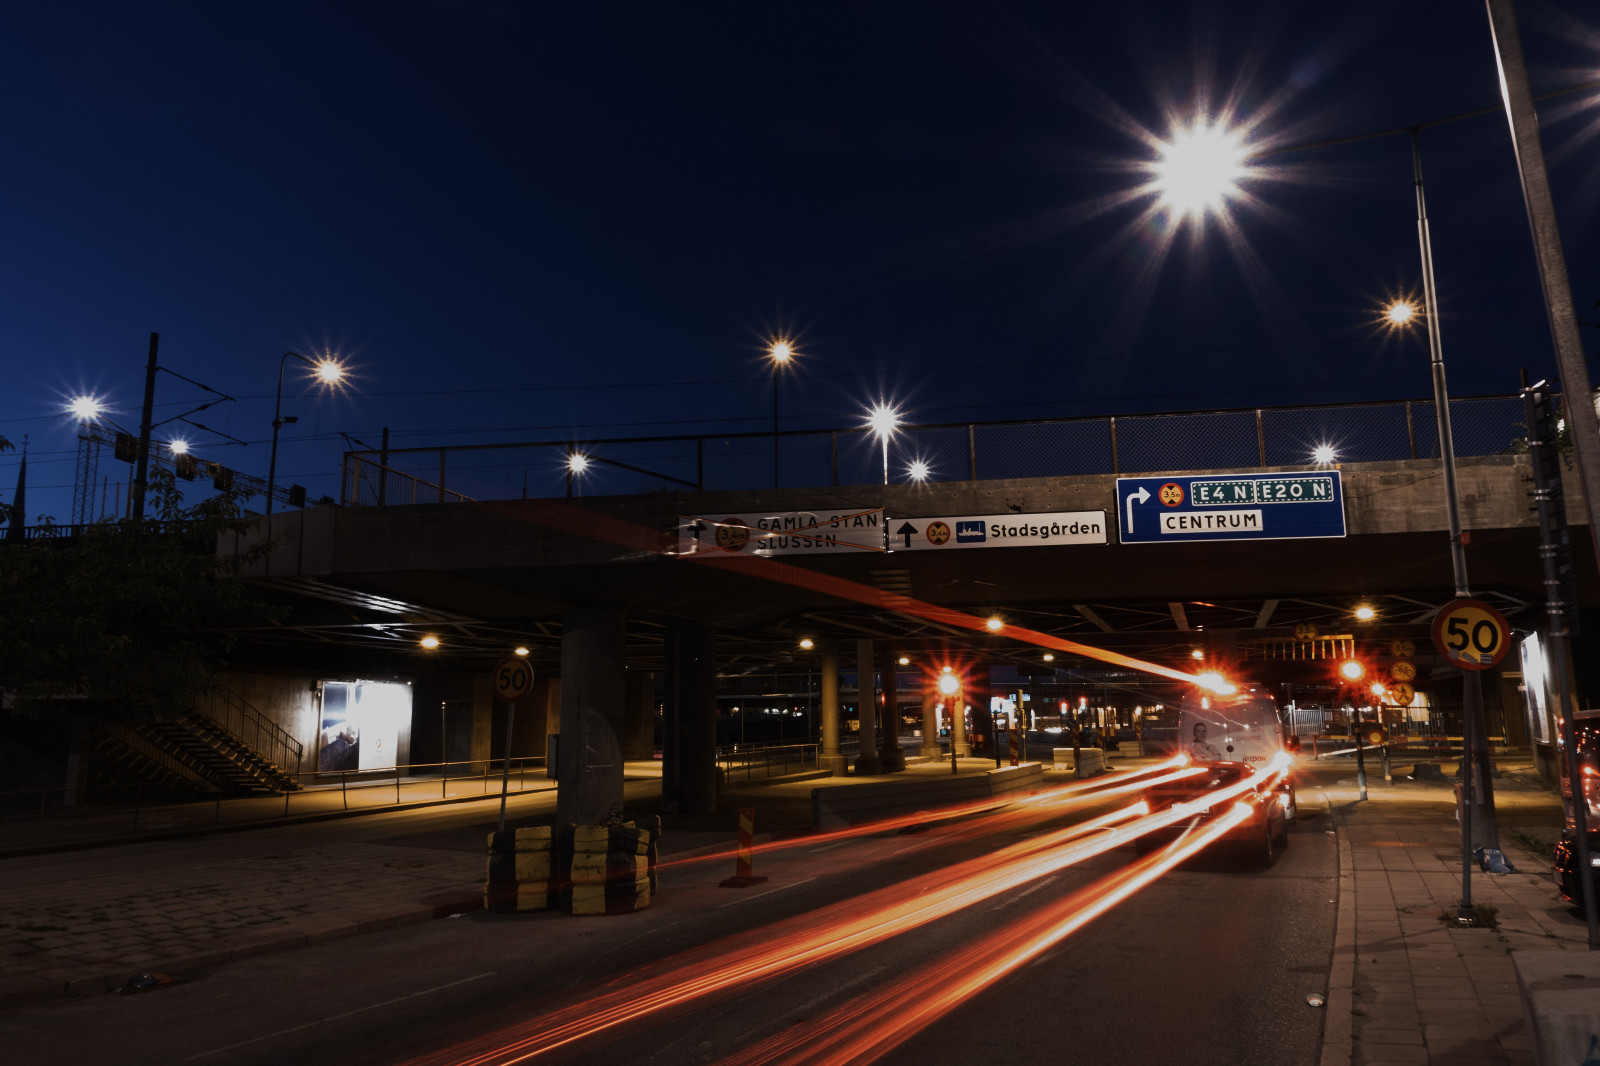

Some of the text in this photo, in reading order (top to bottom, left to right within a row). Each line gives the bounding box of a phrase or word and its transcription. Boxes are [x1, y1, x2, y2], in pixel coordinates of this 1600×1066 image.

[1200, 485, 1247, 500] E4 N
[1262, 483, 1326, 499] E20 N
[757, 513, 877, 530] GAMLA STAN
[1166, 514, 1257, 529] CENTRUM
[990, 522, 1100, 538] Stadsgården
[757, 534, 837, 549] SLUSSEN
[1448, 617, 1498, 653] 50
[499, 668, 526, 690] 50
